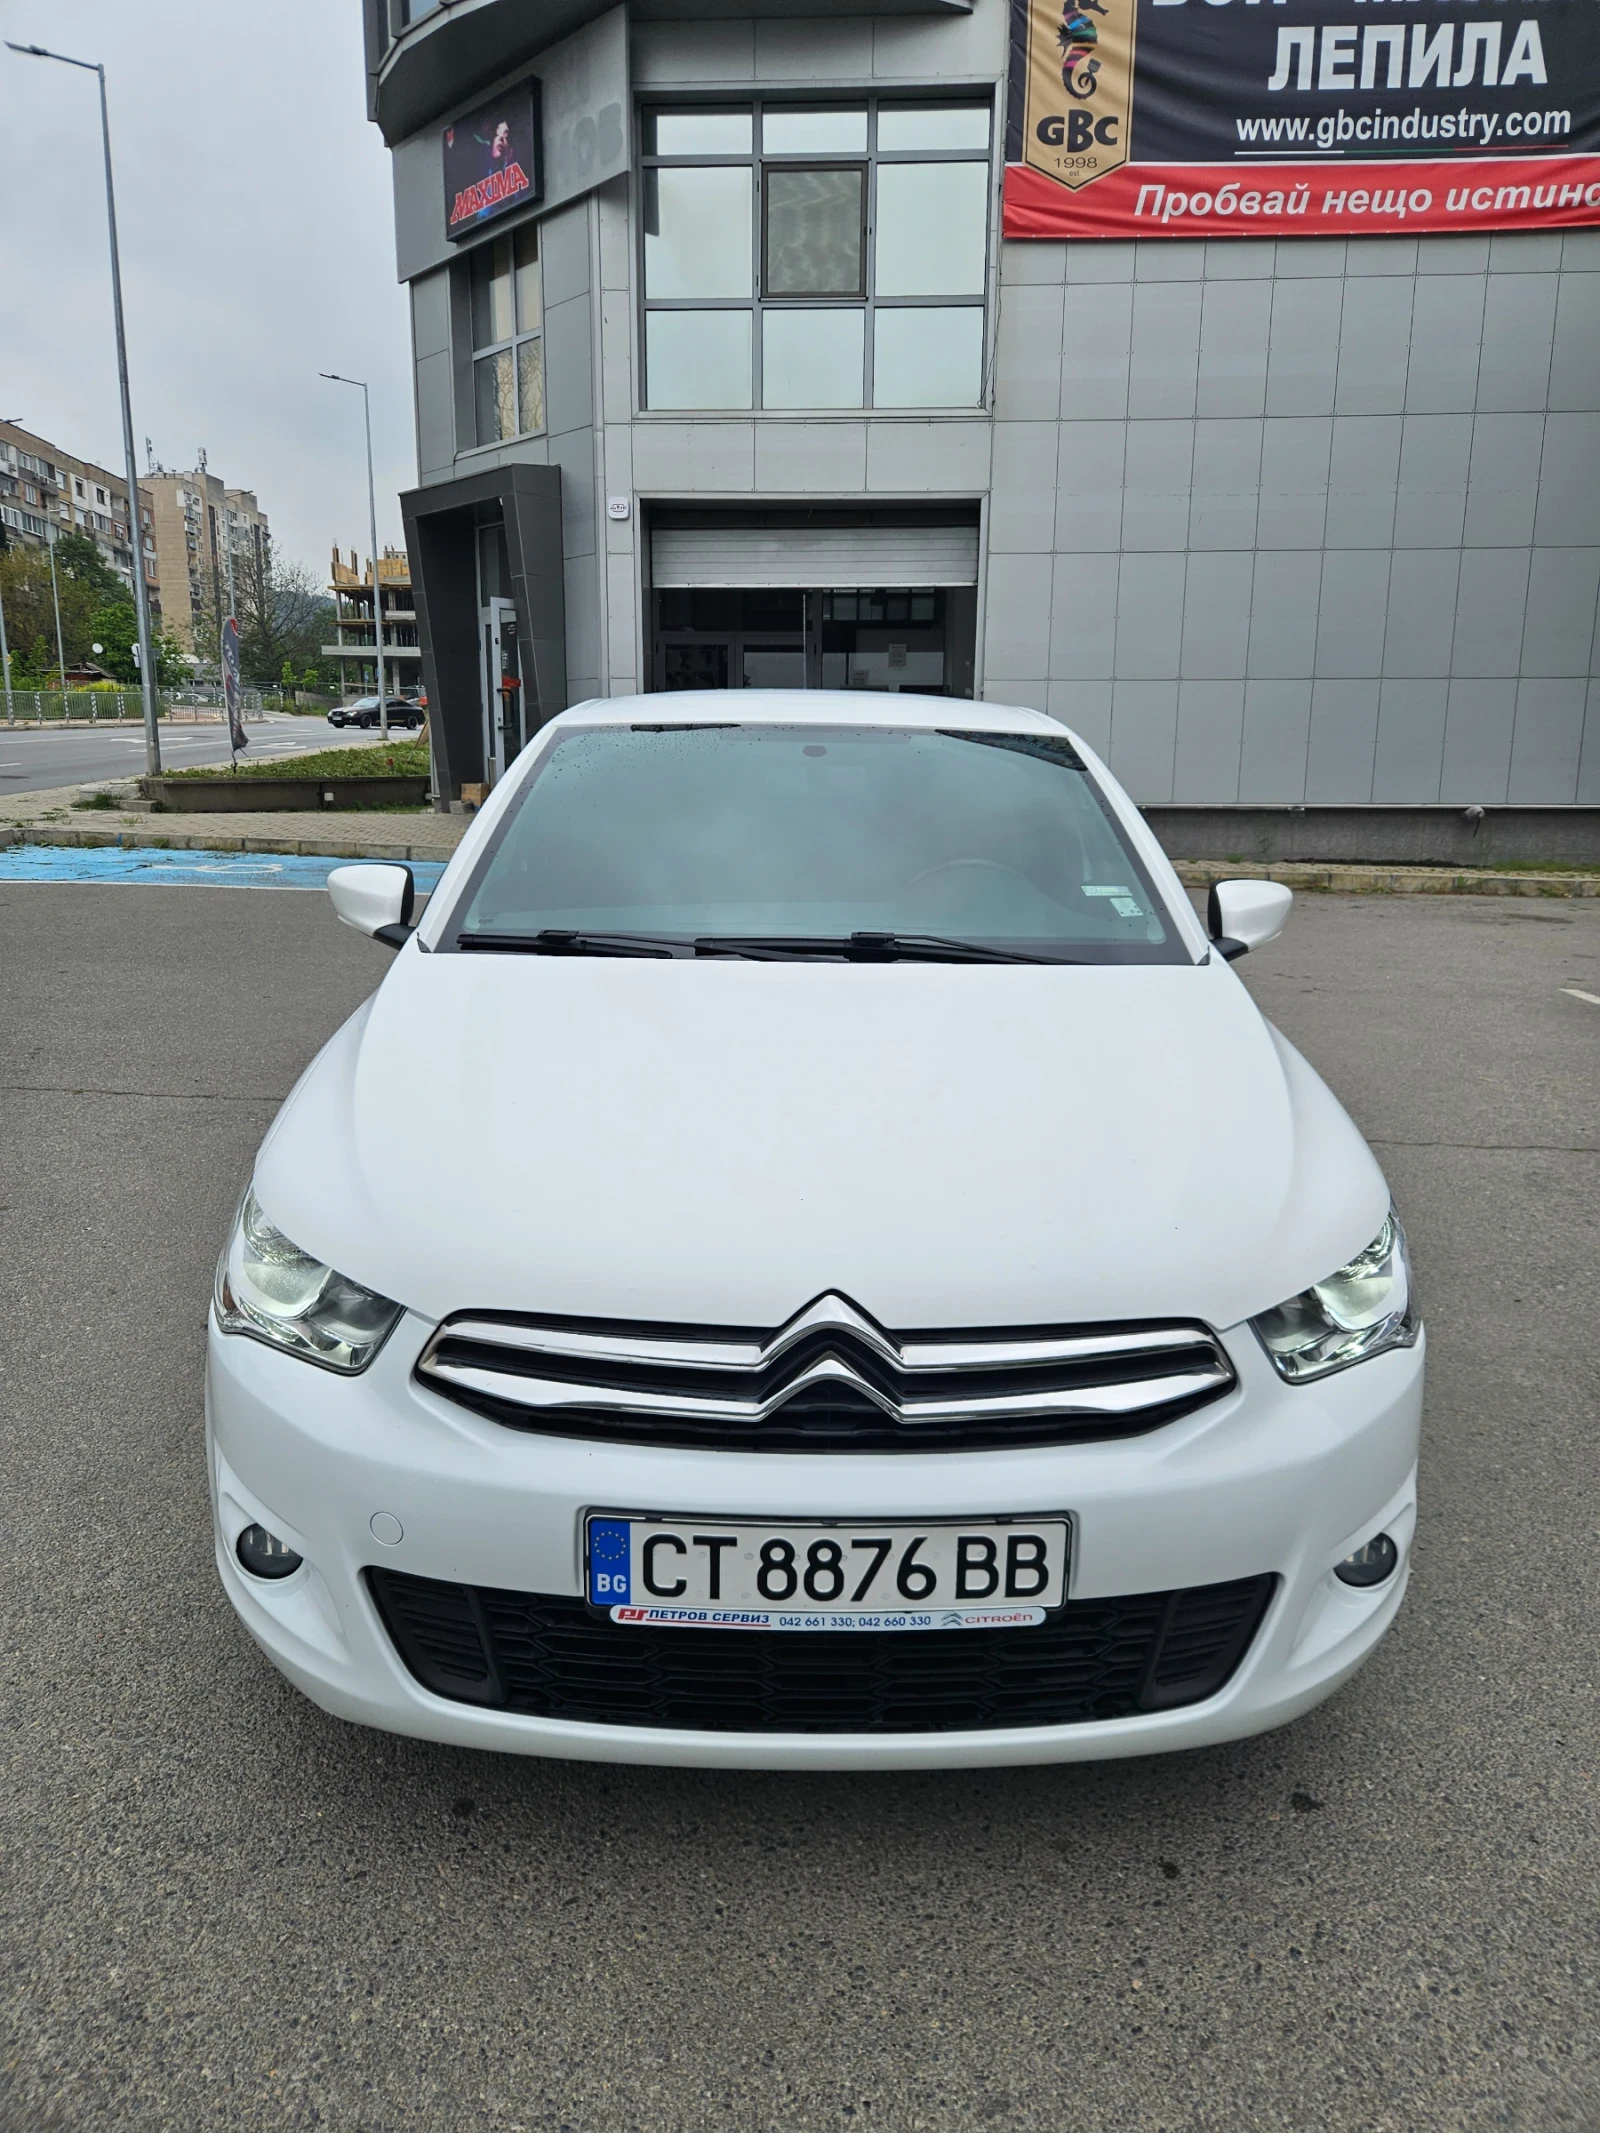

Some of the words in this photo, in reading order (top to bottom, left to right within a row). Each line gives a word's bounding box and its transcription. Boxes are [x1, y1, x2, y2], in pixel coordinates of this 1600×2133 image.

[1267, 20, 1548, 91] ЛЕПИЛА
[1036, 109, 1118, 153] GBC
[1236, 109, 1571, 147] www.gbcindustry.com
[1053, 157, 1097, 169] 1998
[450, 162, 529, 225] MAXIMA
[1134, 183, 1311, 223] Пробвай
[1321, 188, 1432, 219] нещо
[597, 1573, 627, 1593] BG
[642, 1533, 738, 1600] CT
[756, 1536, 938, 1602] 8876
[955, 1534, 1050, 1599] BB
[649, 1609, 708, 1621] ПЕТРОВ
[712, 1613, 770, 1624] СЕРВИЗ
[779, 1617, 801, 1627] 042
[805, 1617, 826, 1627] 661
[830, 1617, 855, 1627] 330;
[858, 1617, 881, 1627] 042
[884, 1617, 906, 1627] 660
[909, 1616, 931, 1626] 330
